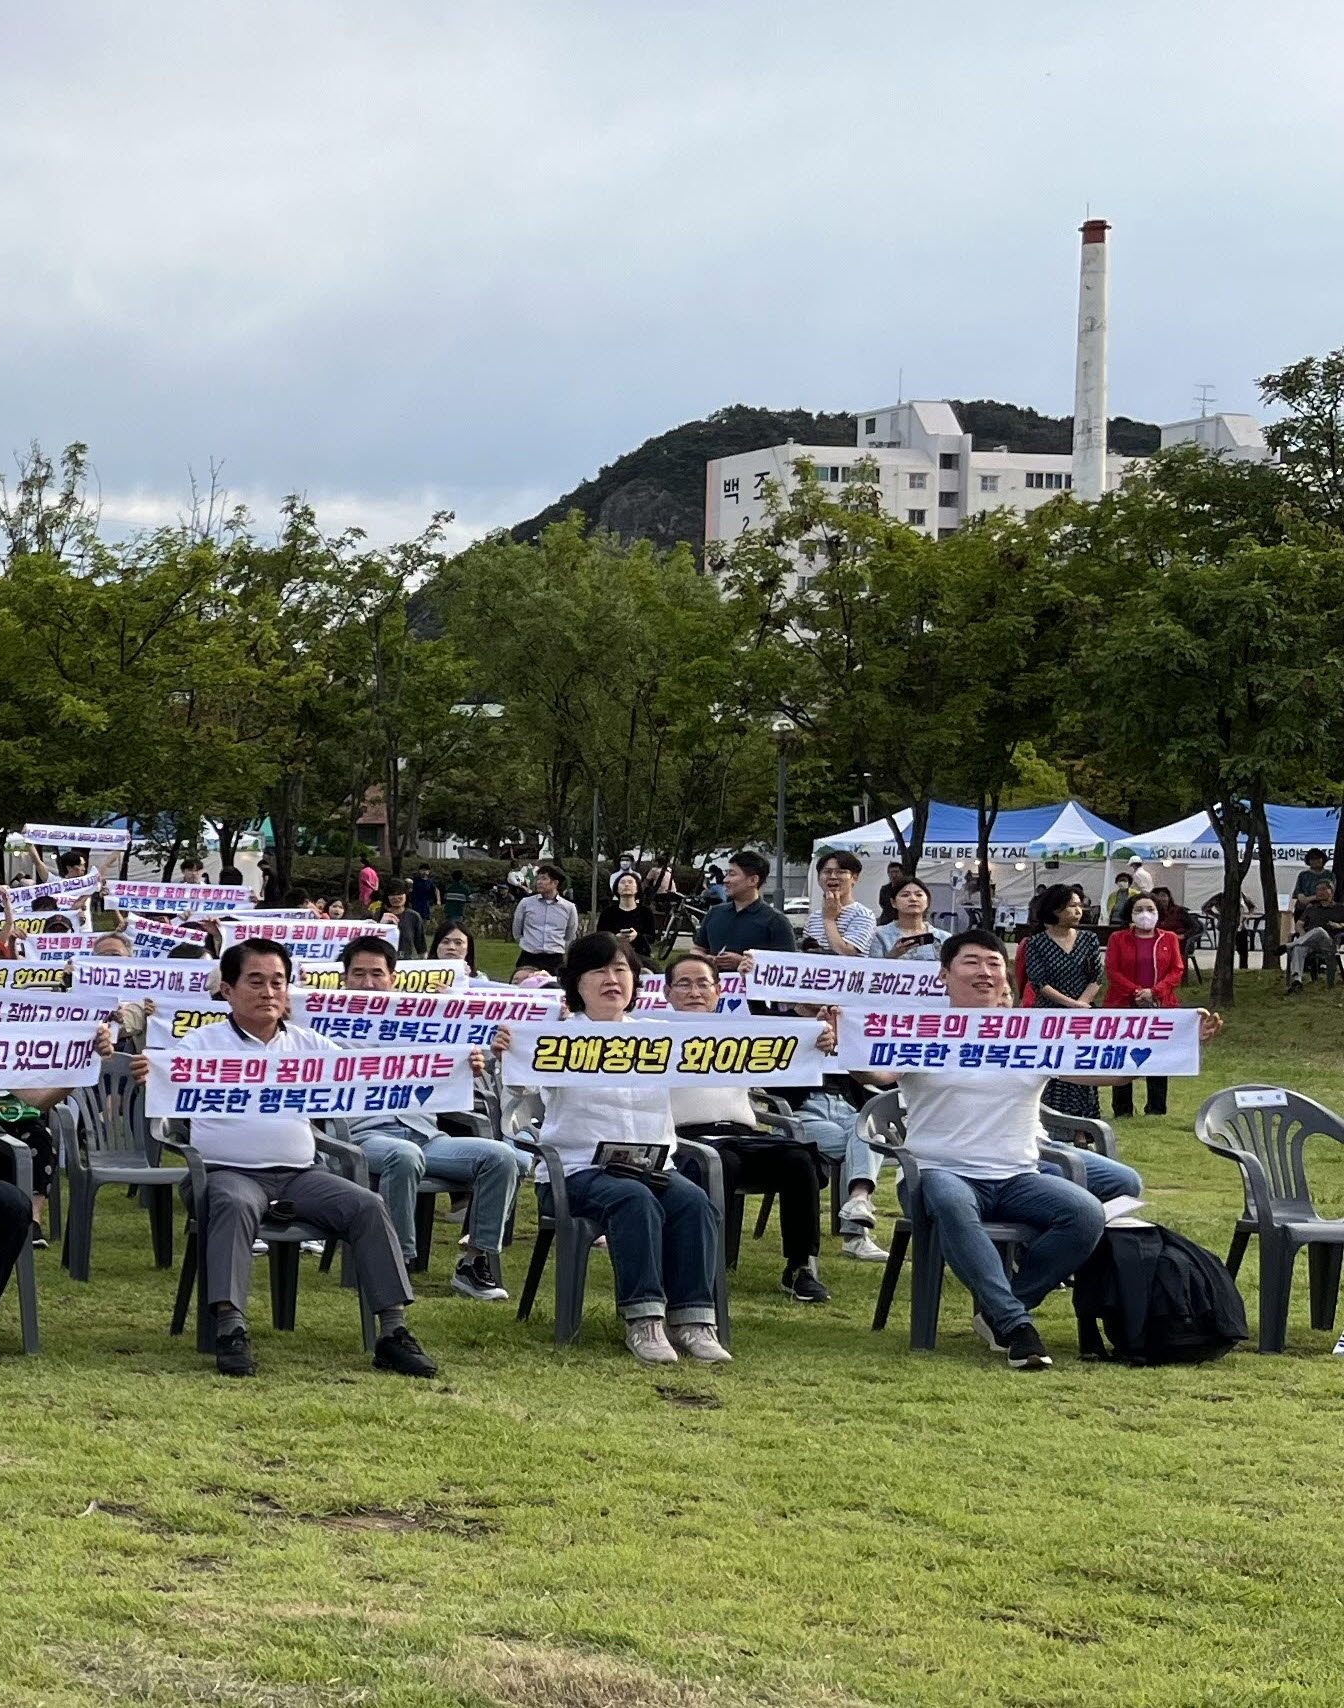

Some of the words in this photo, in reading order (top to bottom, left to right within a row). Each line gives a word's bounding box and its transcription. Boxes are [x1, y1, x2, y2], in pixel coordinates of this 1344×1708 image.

[1002, 847, 1028, 858] TAIL
[115, 883, 159, 898] 청년들의
[164, 886, 185, 898] 꿈이
[118, 898, 151, 909] 따뜻한
[36, 937, 82, 950] 청년들의
[233, 924, 287, 940] 청년들의
[292, 924, 318, 940] 꿈이
[79, 967, 120, 986] 너하고
[123, 969, 164, 991] 싶은거
[168, 974, 185, 992] 해,
[753, 964, 796, 986] 너하고
[799, 966, 844, 991] 싶은거
[846, 970, 865, 995] 해,
[868, 972, 915, 996] 잘하고
[304, 992, 388, 1015] 청년들의
[395, 996, 434, 1017] 꿈이
[444, 998, 548, 1021] 이루어지는
[310, 1016, 373, 1040] 따뜻한
[378, 1019, 459, 1044] 행복도시
[863, 1012, 969, 1040] 청년들의
[977, 1015, 1030, 1040] 꿈이
[1040, 1014, 1175, 1041] 이루어지는
[14, 1039, 95, 1072] 있으니까!
[169, 1056, 267, 1084] 청년들의
[276, 1057, 323, 1084] 꿈이
[333, 1053, 455, 1083] 이루어지는
[531, 1035, 671, 1074] 김해청년
[677, 1035, 798, 1074] 화이팅!
[868, 1042, 951, 1068] 따뜻한
[958, 1044, 1063, 1070] 행복도시
[1074, 1044, 1129, 1071] 김해
[175, 1087, 252, 1114] 따뜻한
[258, 1088, 353, 1114] 행복도시
[364, 1085, 413, 1112] 김해
